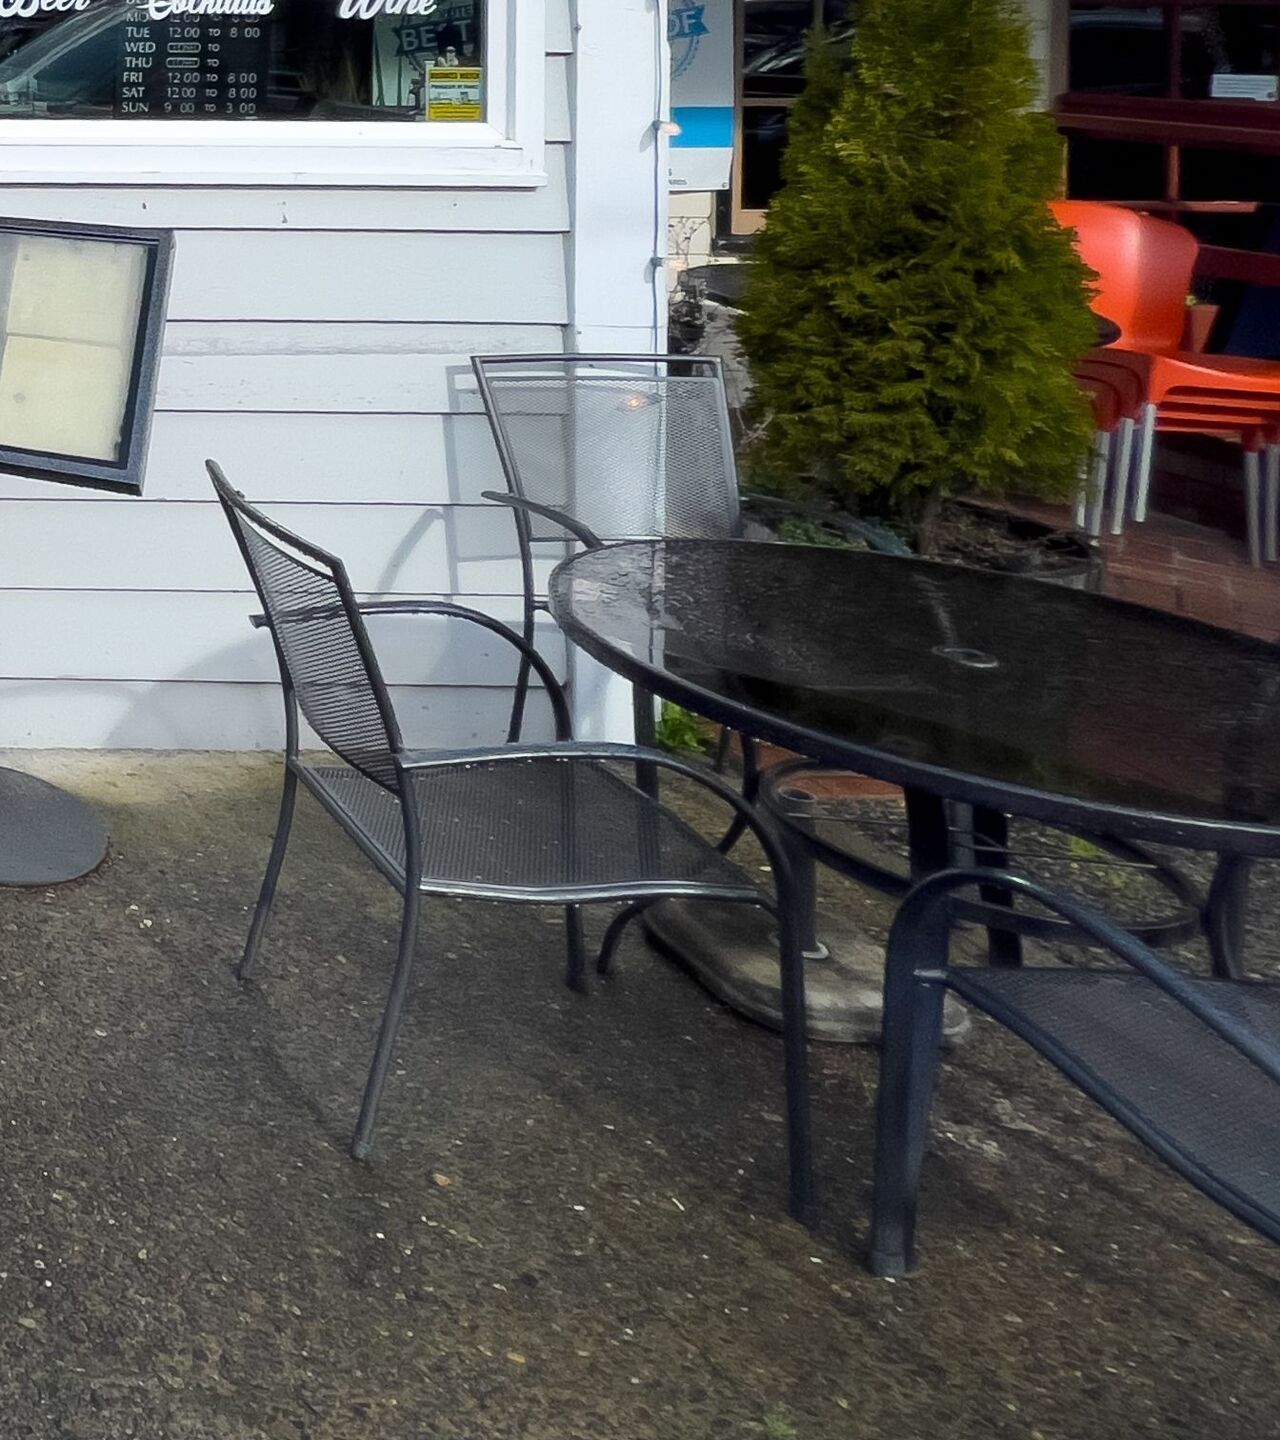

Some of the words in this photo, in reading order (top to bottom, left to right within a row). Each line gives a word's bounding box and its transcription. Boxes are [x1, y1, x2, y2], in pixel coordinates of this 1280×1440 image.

[126, 27, 150, 38] TUE
[401, 20, 471, 51] BET
[125, 42, 156, 52] WED
[125, 57, 152, 68] THU
[123, 72, 142, 83] FRI
[122, 87, 145, 98] SAT
[122, 102, 149, 113] SUN
